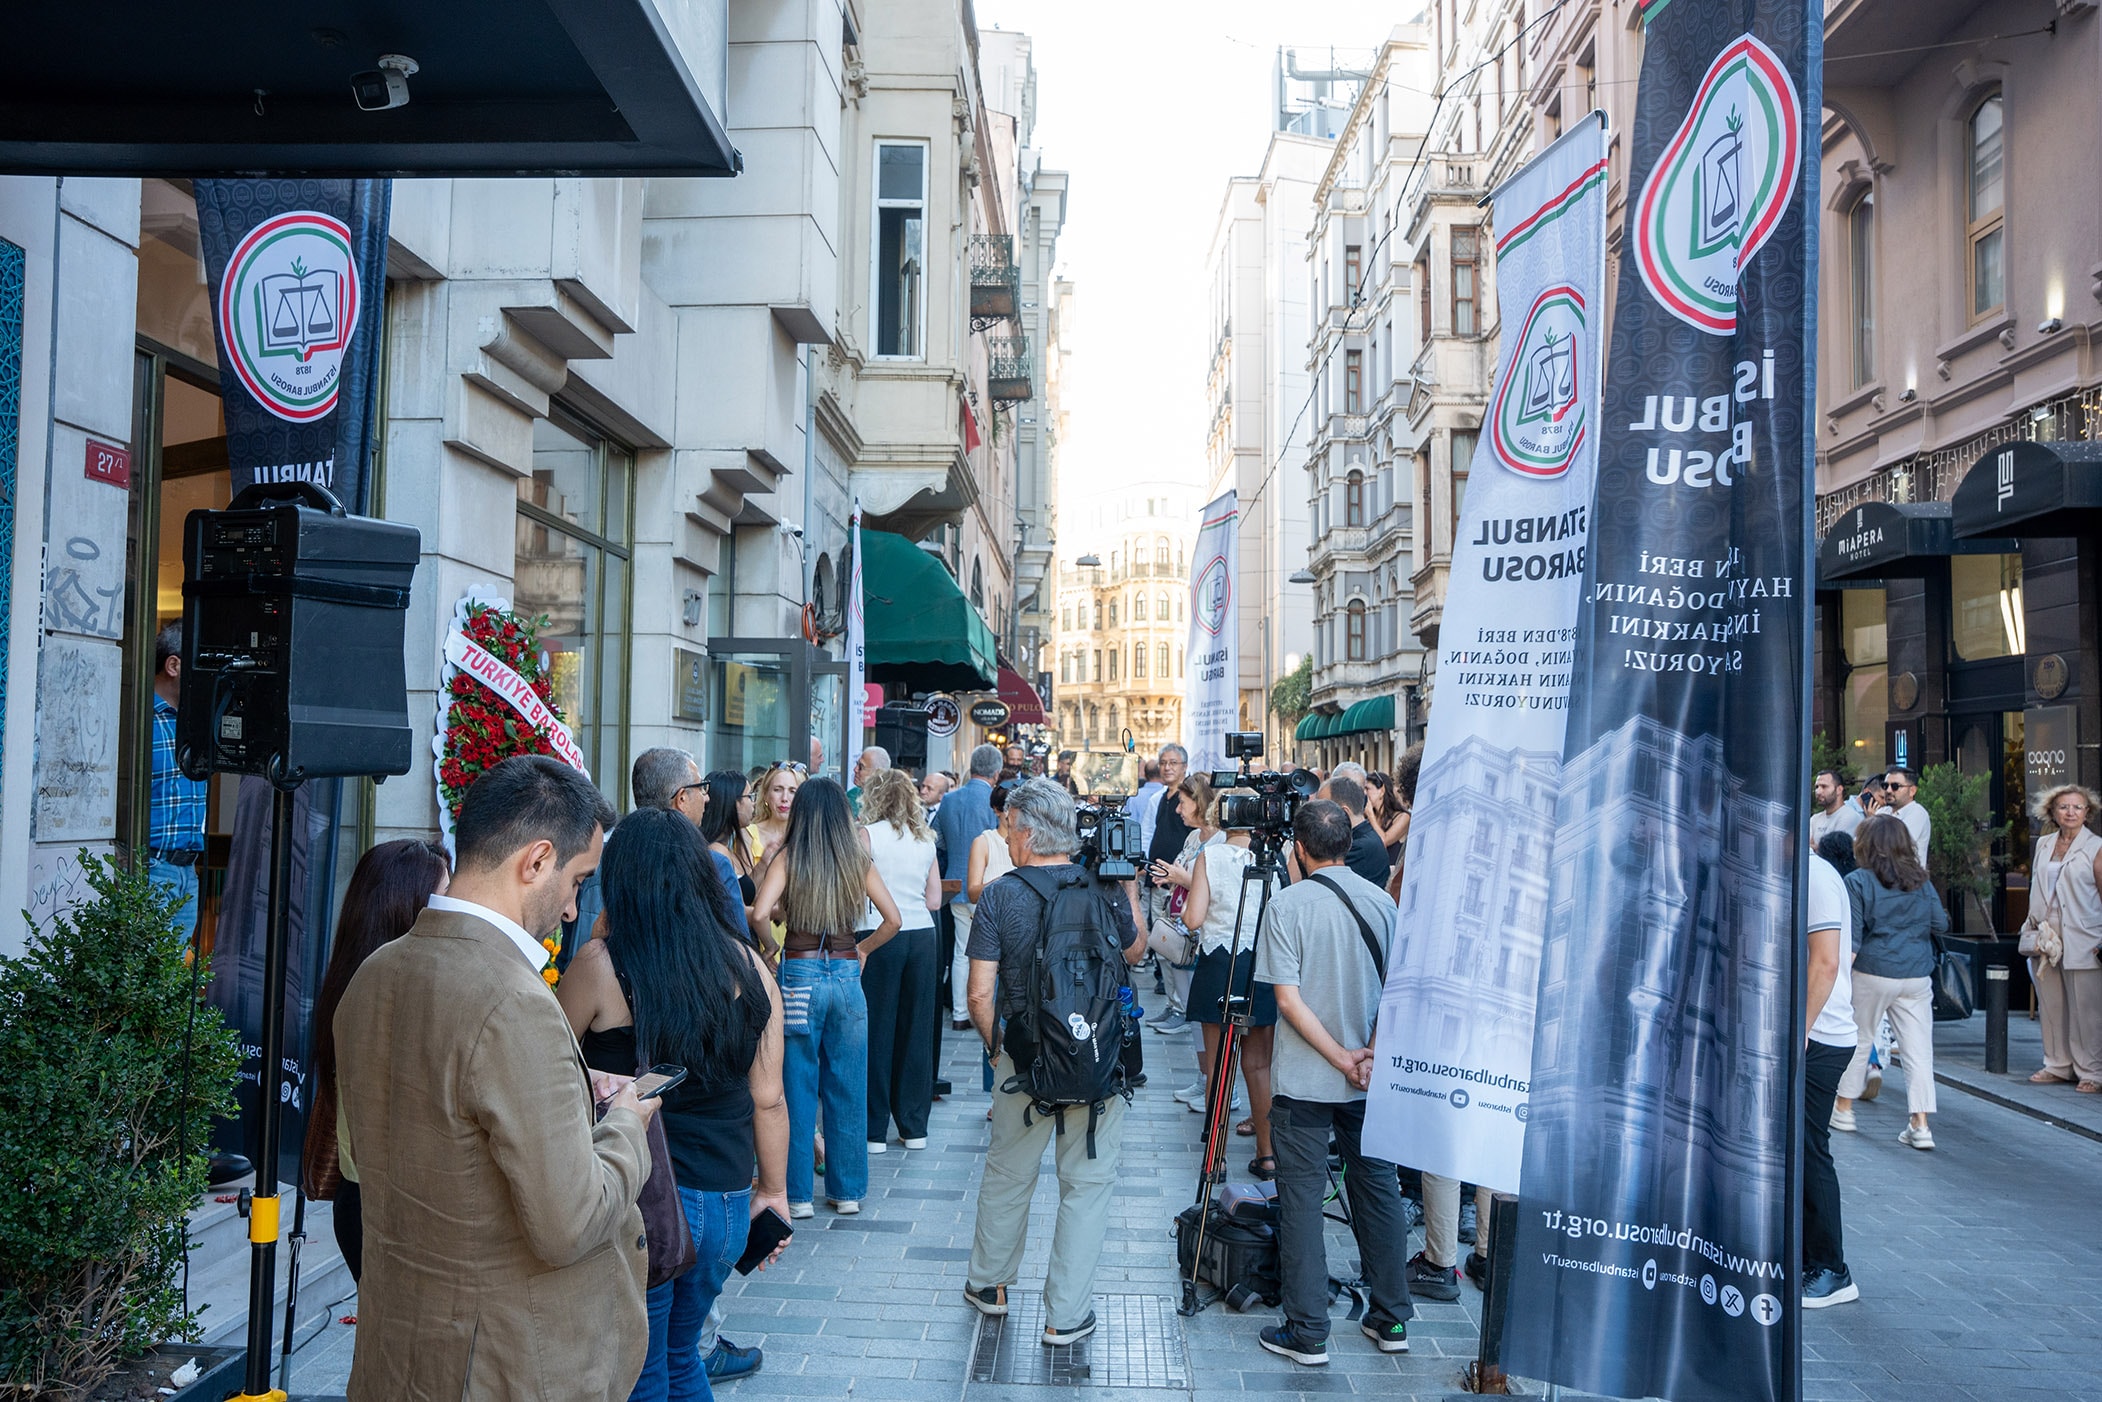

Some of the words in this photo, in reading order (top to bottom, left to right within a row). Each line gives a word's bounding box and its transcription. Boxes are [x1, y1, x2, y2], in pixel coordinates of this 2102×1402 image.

[1850, 548, 1871, 561] HOTEL
[460, 645, 534, 709] TÜRKİYE
[973, 708, 1005, 717] NOMADS
